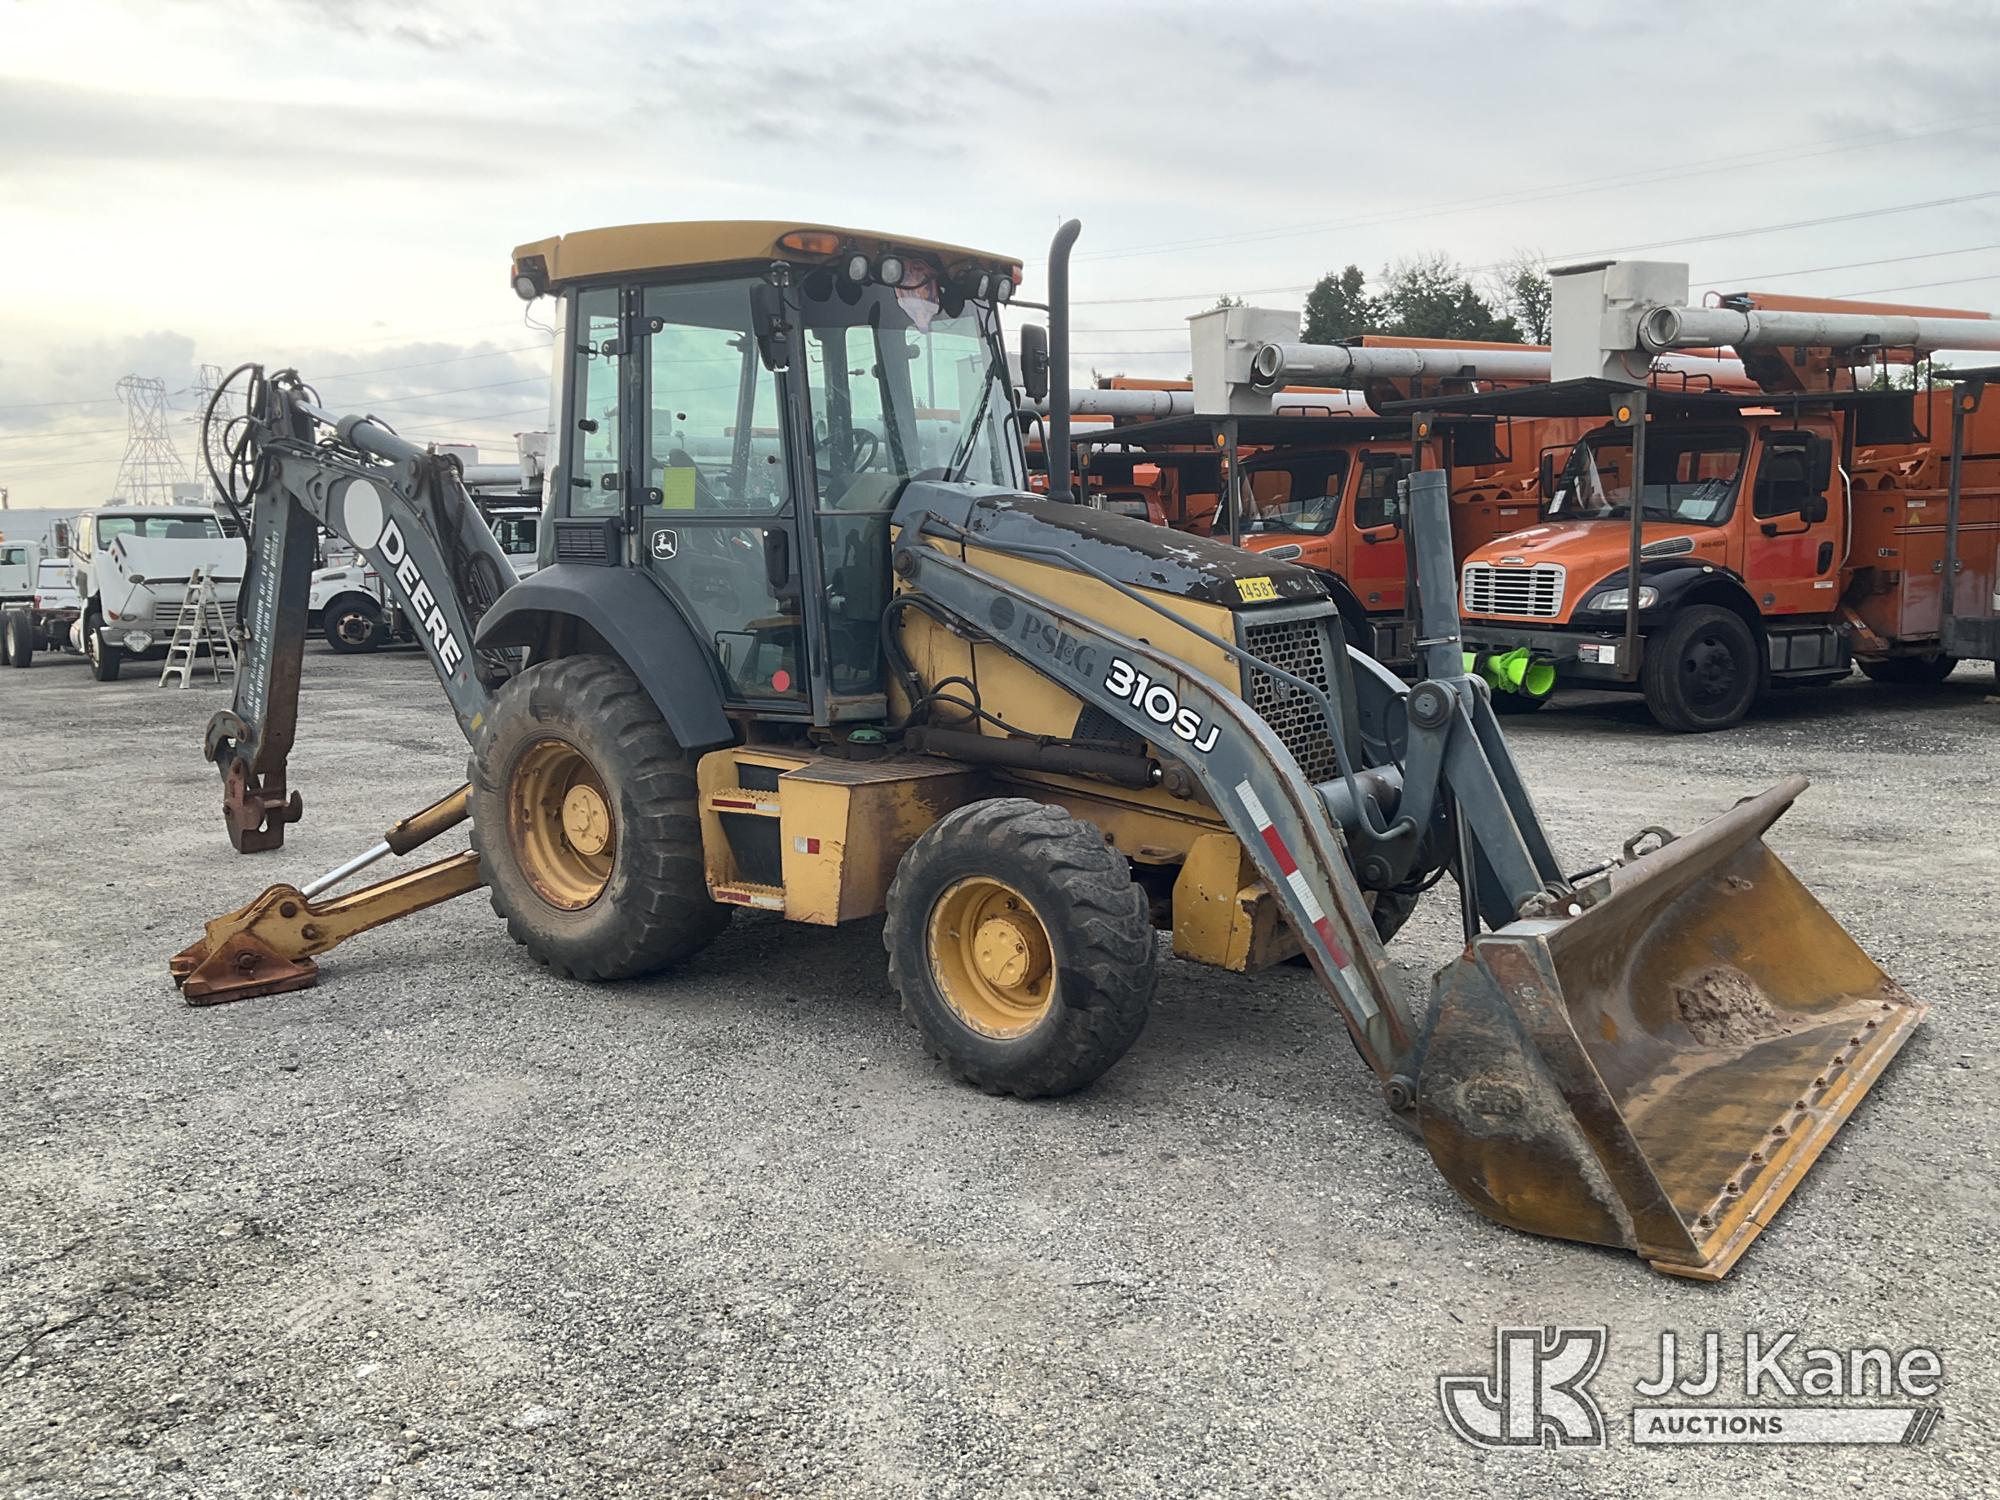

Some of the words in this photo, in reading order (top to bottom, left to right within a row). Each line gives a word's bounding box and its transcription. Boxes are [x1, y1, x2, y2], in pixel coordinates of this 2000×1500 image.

[377, 516, 464, 678] DEERE
[1238, 580, 1277, 599] 14581
[247, 683, 255, 707] KEEP
[1104, 658, 1221, 753] 310SJ
